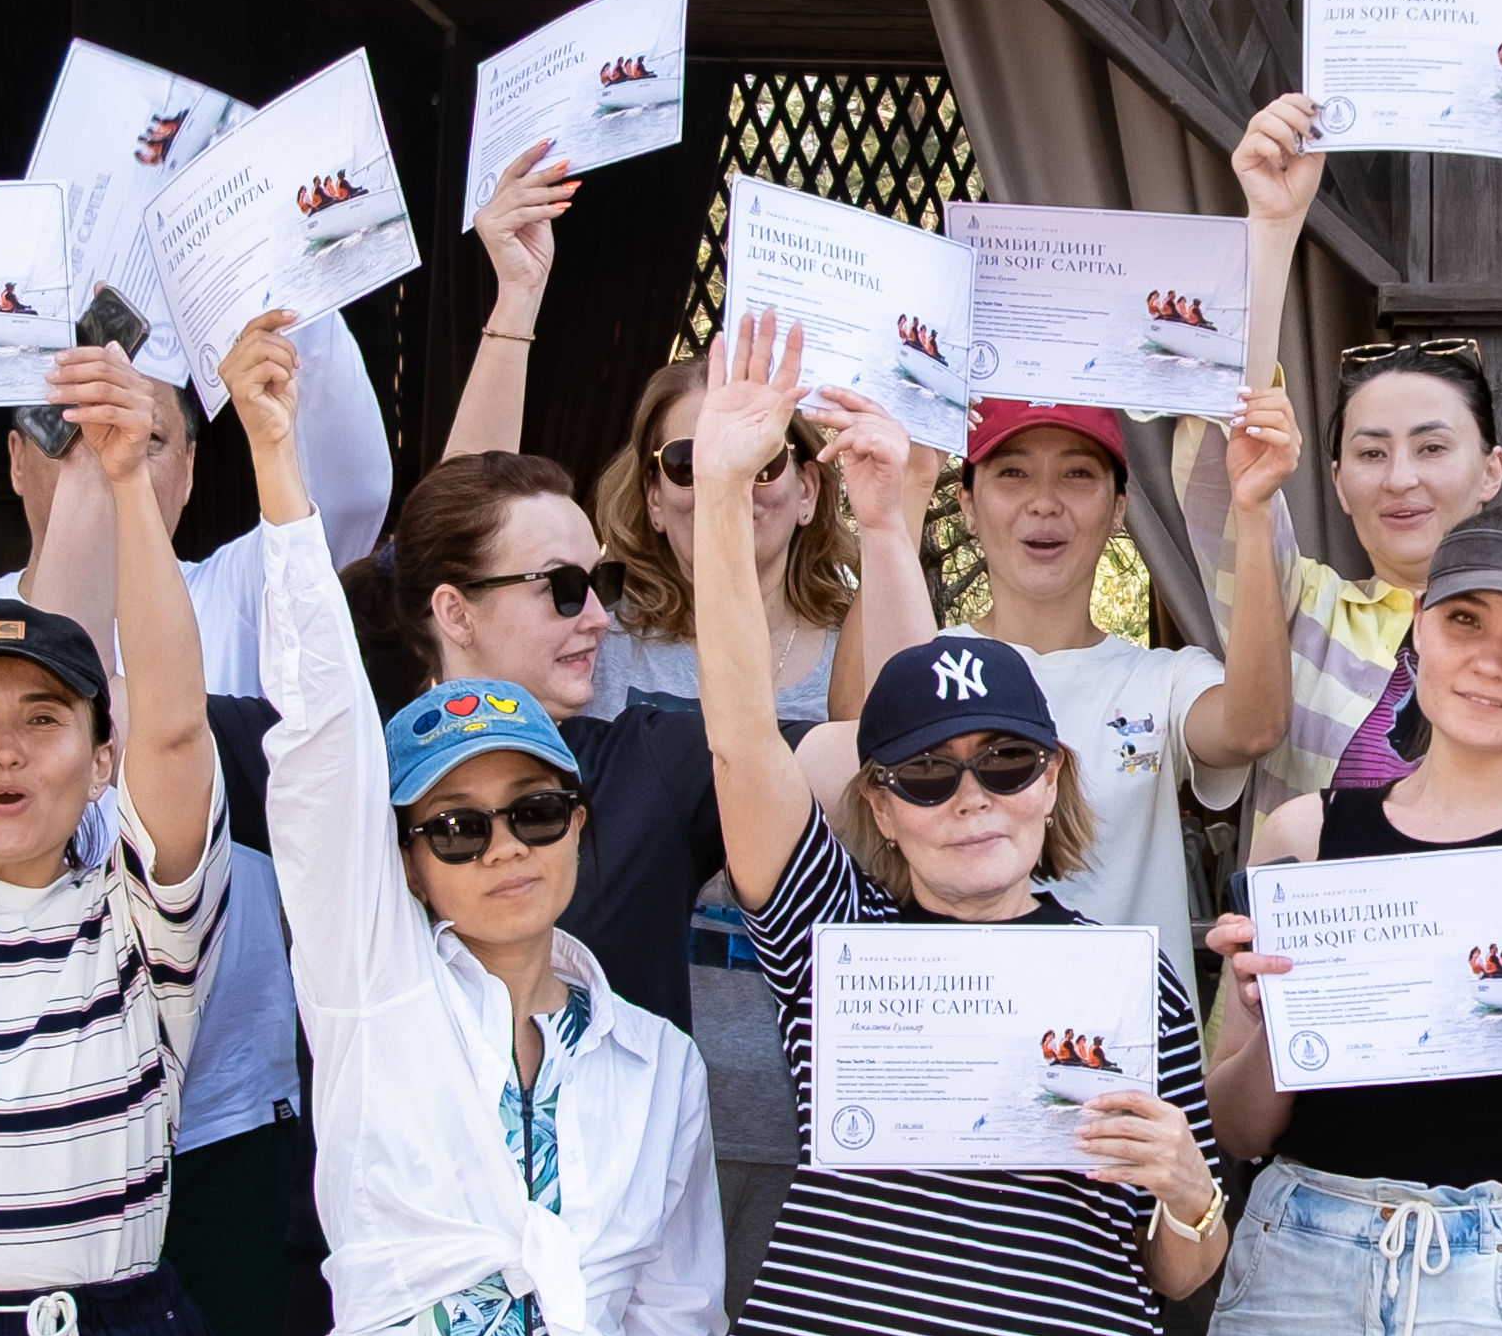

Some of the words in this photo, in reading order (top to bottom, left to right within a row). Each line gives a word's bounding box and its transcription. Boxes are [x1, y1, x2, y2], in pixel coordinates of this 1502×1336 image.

[1324, 7, 1355, 21] ДЛЯ
[1359, 6, 1400, 22] SQIF
[1406, 7, 1479, 25] CAPITAL
[216, 179, 274, 229] CAPITAL
[747, 223, 868, 267] ТИМБИЛДИНГ
[966, 235, 1107, 257] ТИМБИЛДИНГ
[747, 245, 776, 263] ДЛЯ
[781, 252, 816, 273] SQIF
[822, 263, 884, 293] CAPITAL
[977, 255, 1000, 267] ЛЯ
[1004, 256, 1045, 271] SQIF
[1052, 259, 1127, 276] CAPITAL
[1273, 901, 1418, 928] ТИМБИЛДИНГ
[1276, 935, 1309, 951] ДЛЯ
[1314, 930, 1357, 950] SQIF
[1364, 921, 1443, 943] CAPITAL
[836, 974, 995, 994] ТИМБИЛДИНГ
[836, 999, 872, 1016] ДЛЯ
[878, 998, 924, 1017] SQIF
[933, 999, 1018, 1015] CAPITAL
